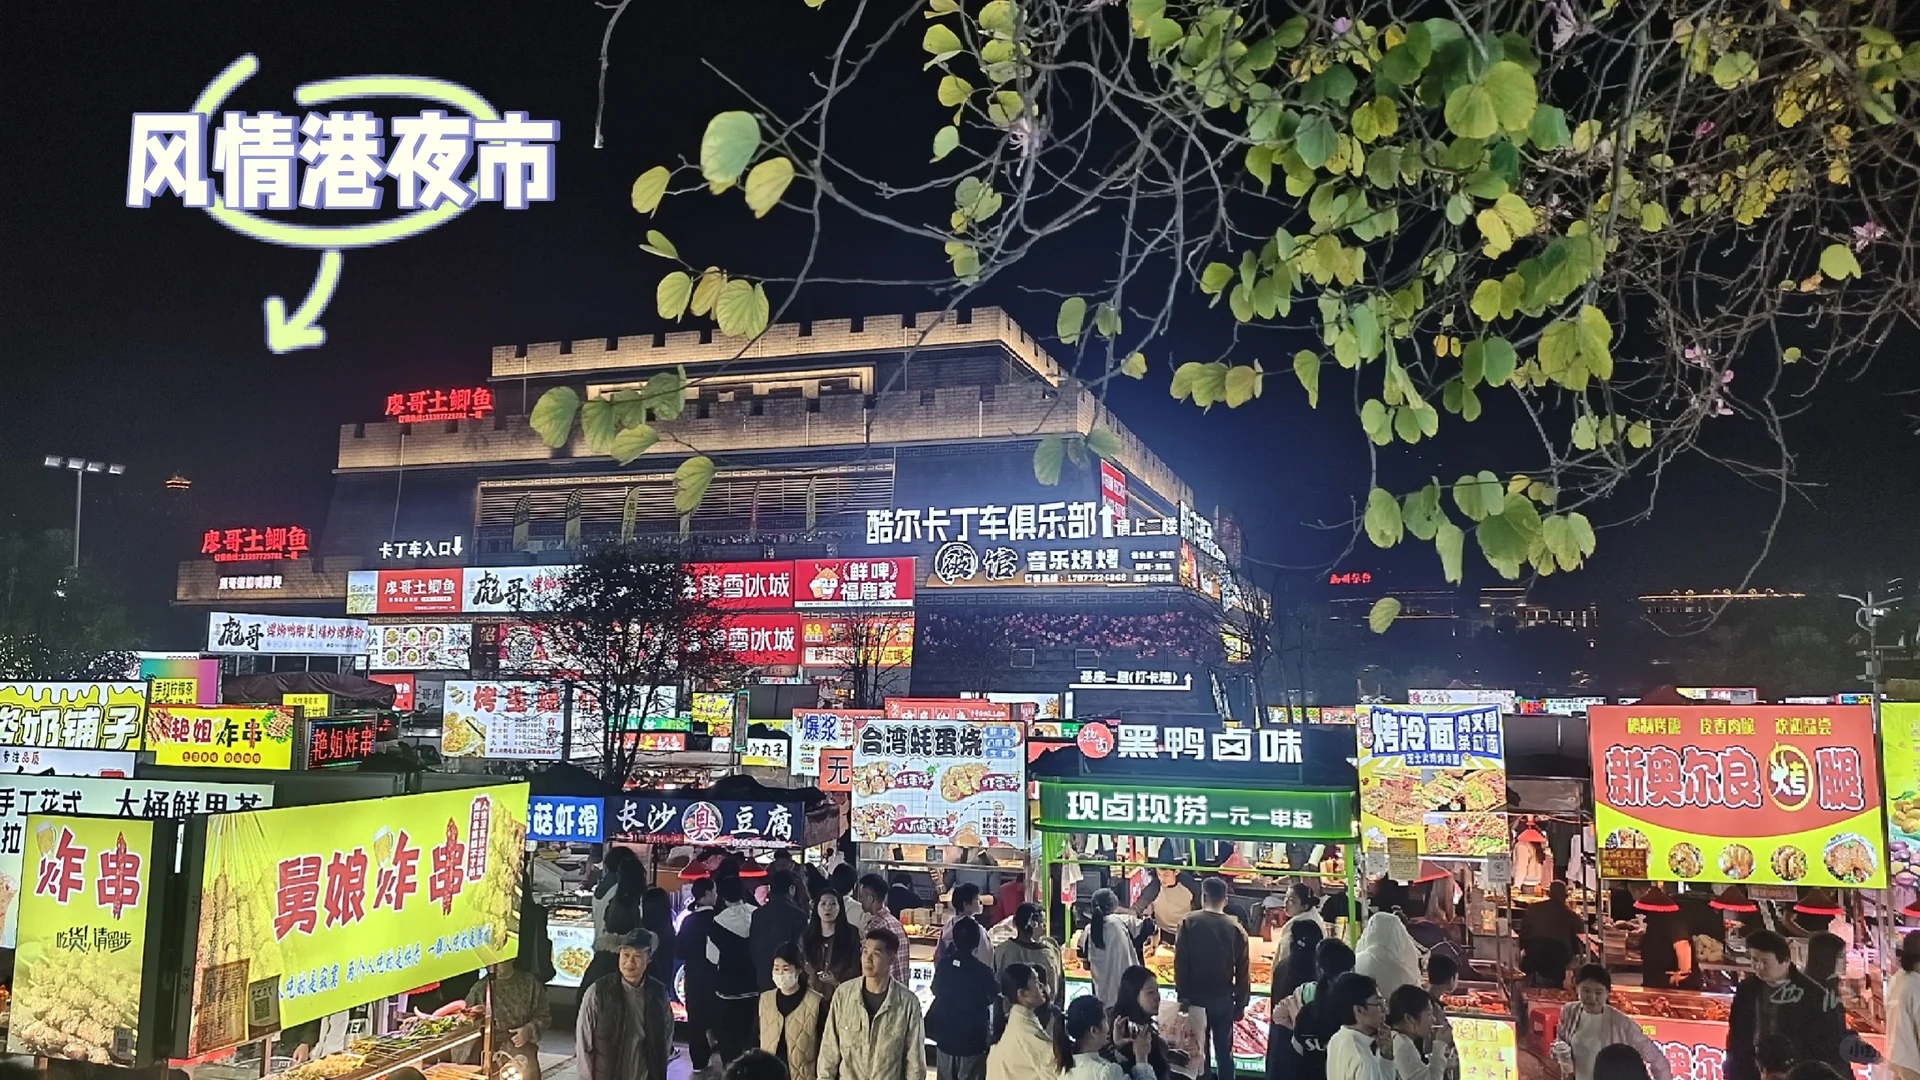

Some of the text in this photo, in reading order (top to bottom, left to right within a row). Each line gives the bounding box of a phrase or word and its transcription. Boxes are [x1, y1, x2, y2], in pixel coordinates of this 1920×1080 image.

[866, 502, 1095, 543] 酷尔卡丁车俱乐部
[1115, 516, 1178, 536] 请上二楼
[379, 542, 450, 559] 卡丁车入口
[1027, 550, 1119, 571] 音乐烧烤
[849, 562, 889, 579] 鲜啤
[840, 581, 897, 600] 福鹿家
[218, 615, 264, 650] 彪哥
[707, 627, 796, 652] 雪冰城
[172, 717, 262, 748] 艳姐炸串
[861, 724, 983, 757] 台湾蚝蛋烧
[1371, 710, 1456, 754] 烤冷面
[1775, 716, 1832, 736] 欢迎品尝
[3, 750, 40, 765] 专注品质
[314, 726, 373, 761] 艳姐炸串
[1117, 725, 1302, 763] 黑鸭卤味
[1606, 744, 1865, 811] 新奥尔良烤腿
[0, 787, 82, 815] 手工花式
[1066, 791, 1313, 829] 现卤现捞一元一串起
[615, 799, 793, 842] 长沙臭豆腐
[2, 822, 20, 854] 拉
[37, 829, 142, 920] 炸串
[274, 829, 465, 942] 舅娘炸串
